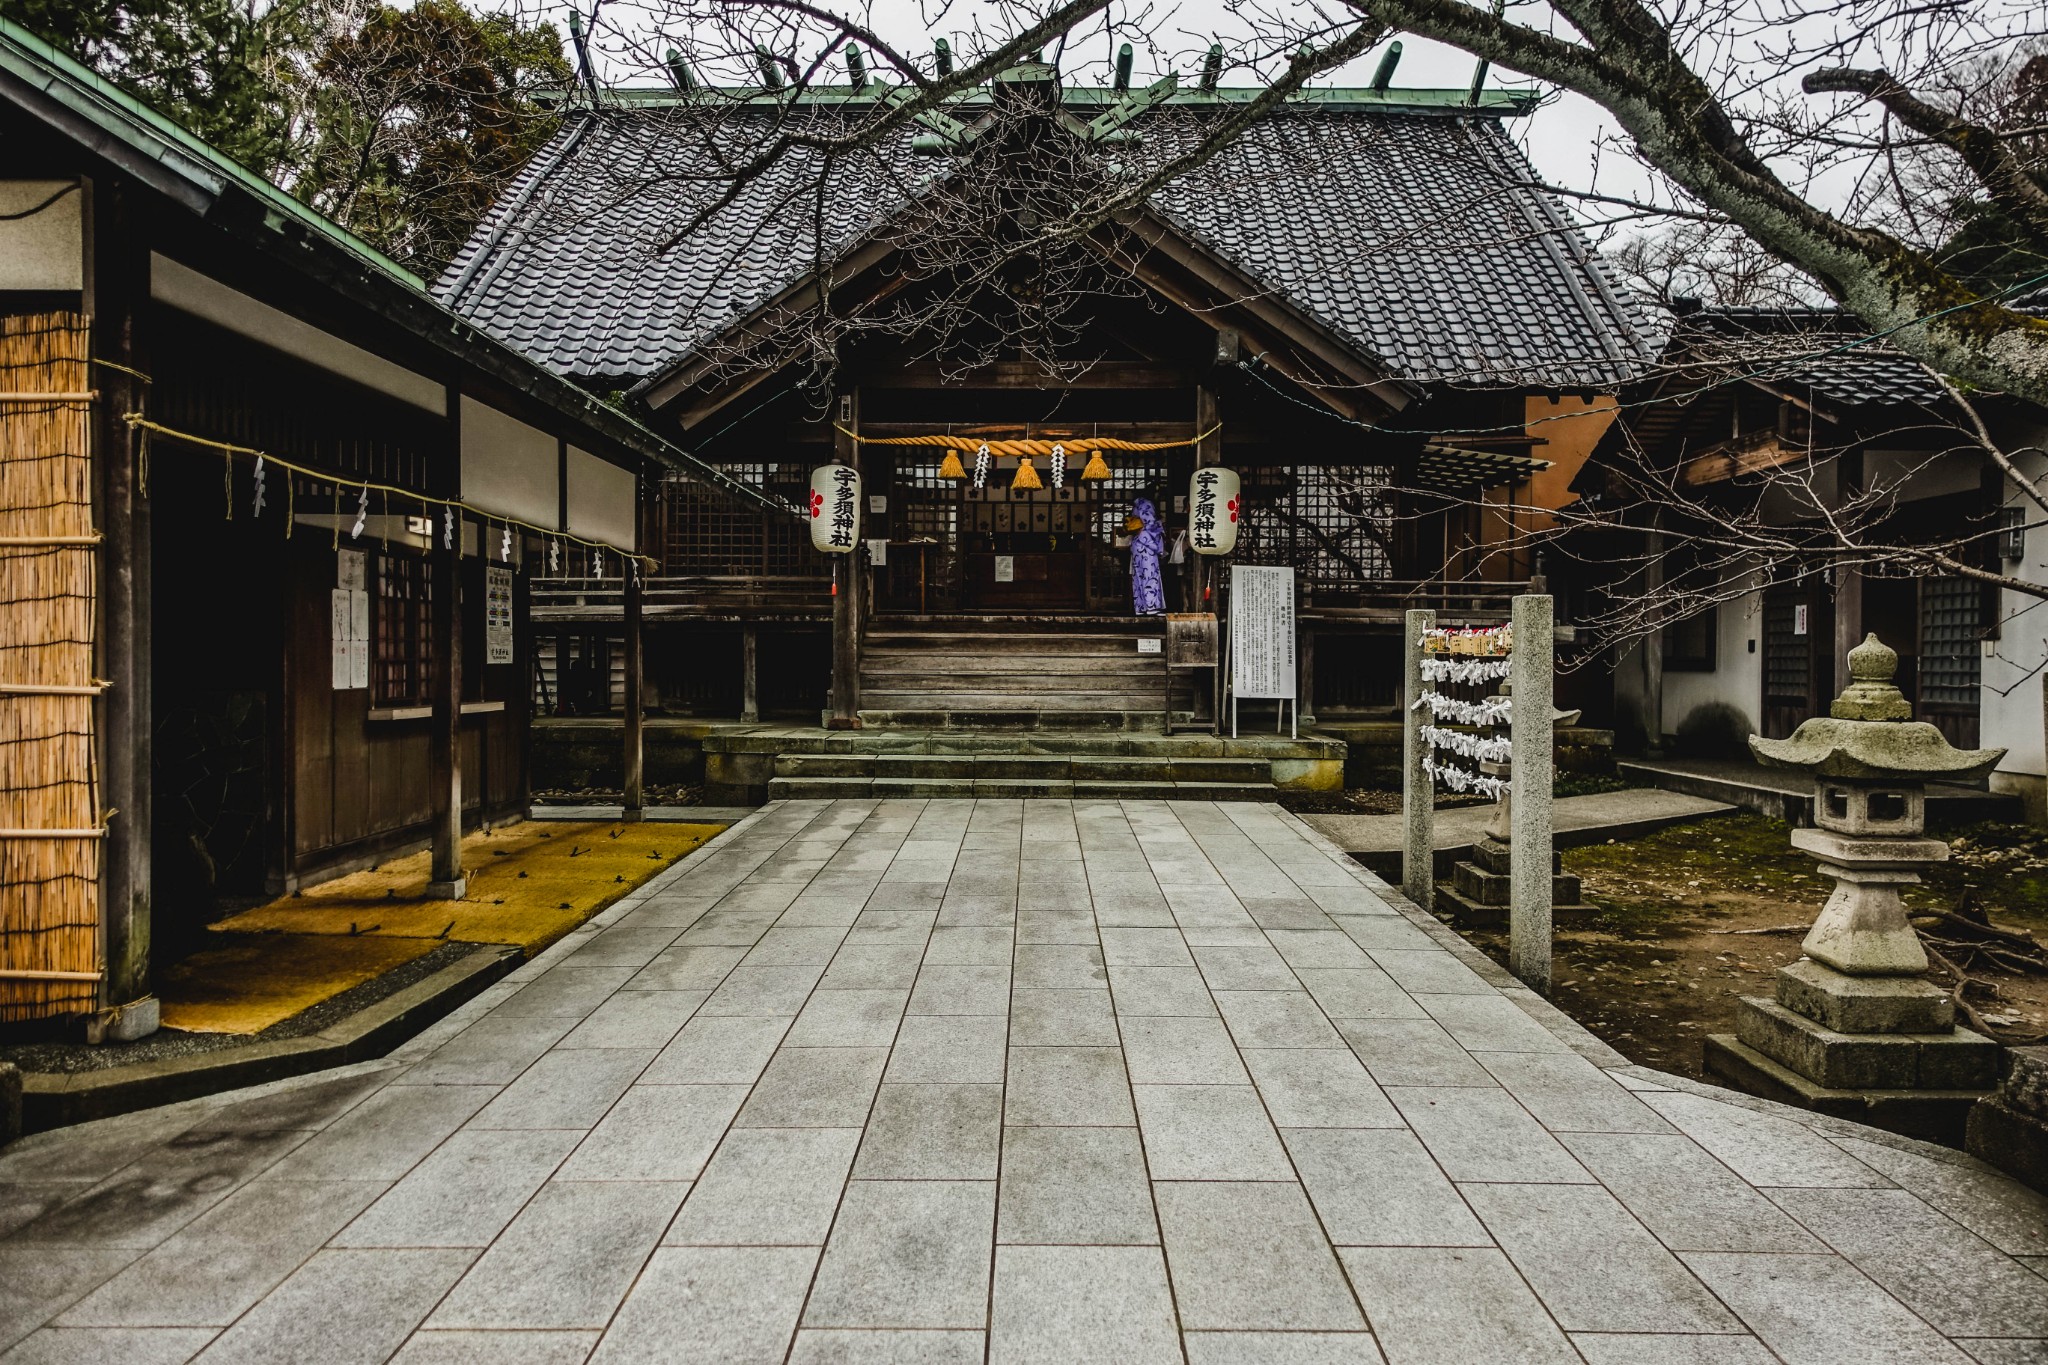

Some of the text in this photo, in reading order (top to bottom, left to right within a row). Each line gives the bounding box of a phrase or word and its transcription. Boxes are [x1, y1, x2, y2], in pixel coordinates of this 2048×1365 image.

[829, 468, 857, 548] 宇多須神社
[1193, 471, 1219, 548] 宇多須神社
